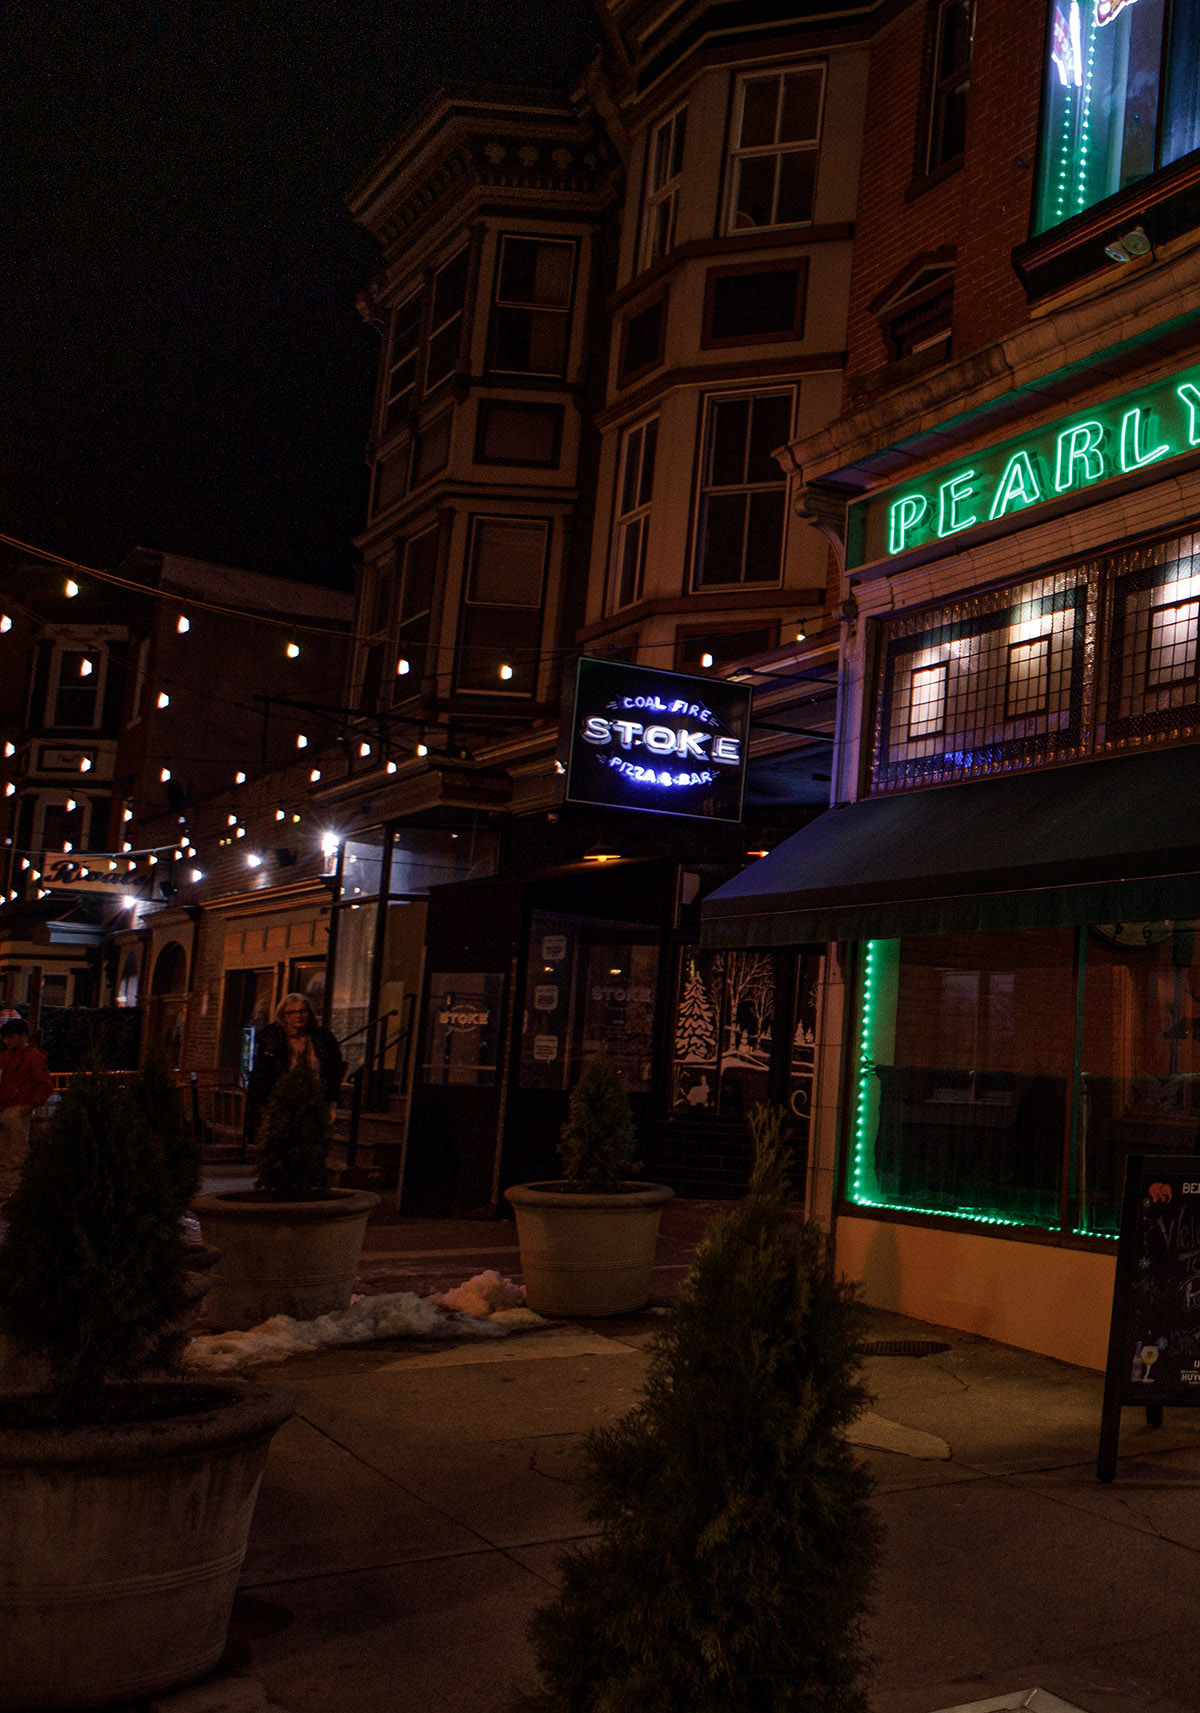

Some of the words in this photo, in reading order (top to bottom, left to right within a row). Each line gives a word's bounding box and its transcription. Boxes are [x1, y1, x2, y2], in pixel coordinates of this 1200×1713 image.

[623, 696, 667, 711] COAL
[671, 699, 712, 722] FIRE
[580, 715, 741, 766] STOKE
[609, 757, 657, 784] PIZZA
[678, 771, 713, 786] BAR
[439, 1012, 488, 1025] STOKE
